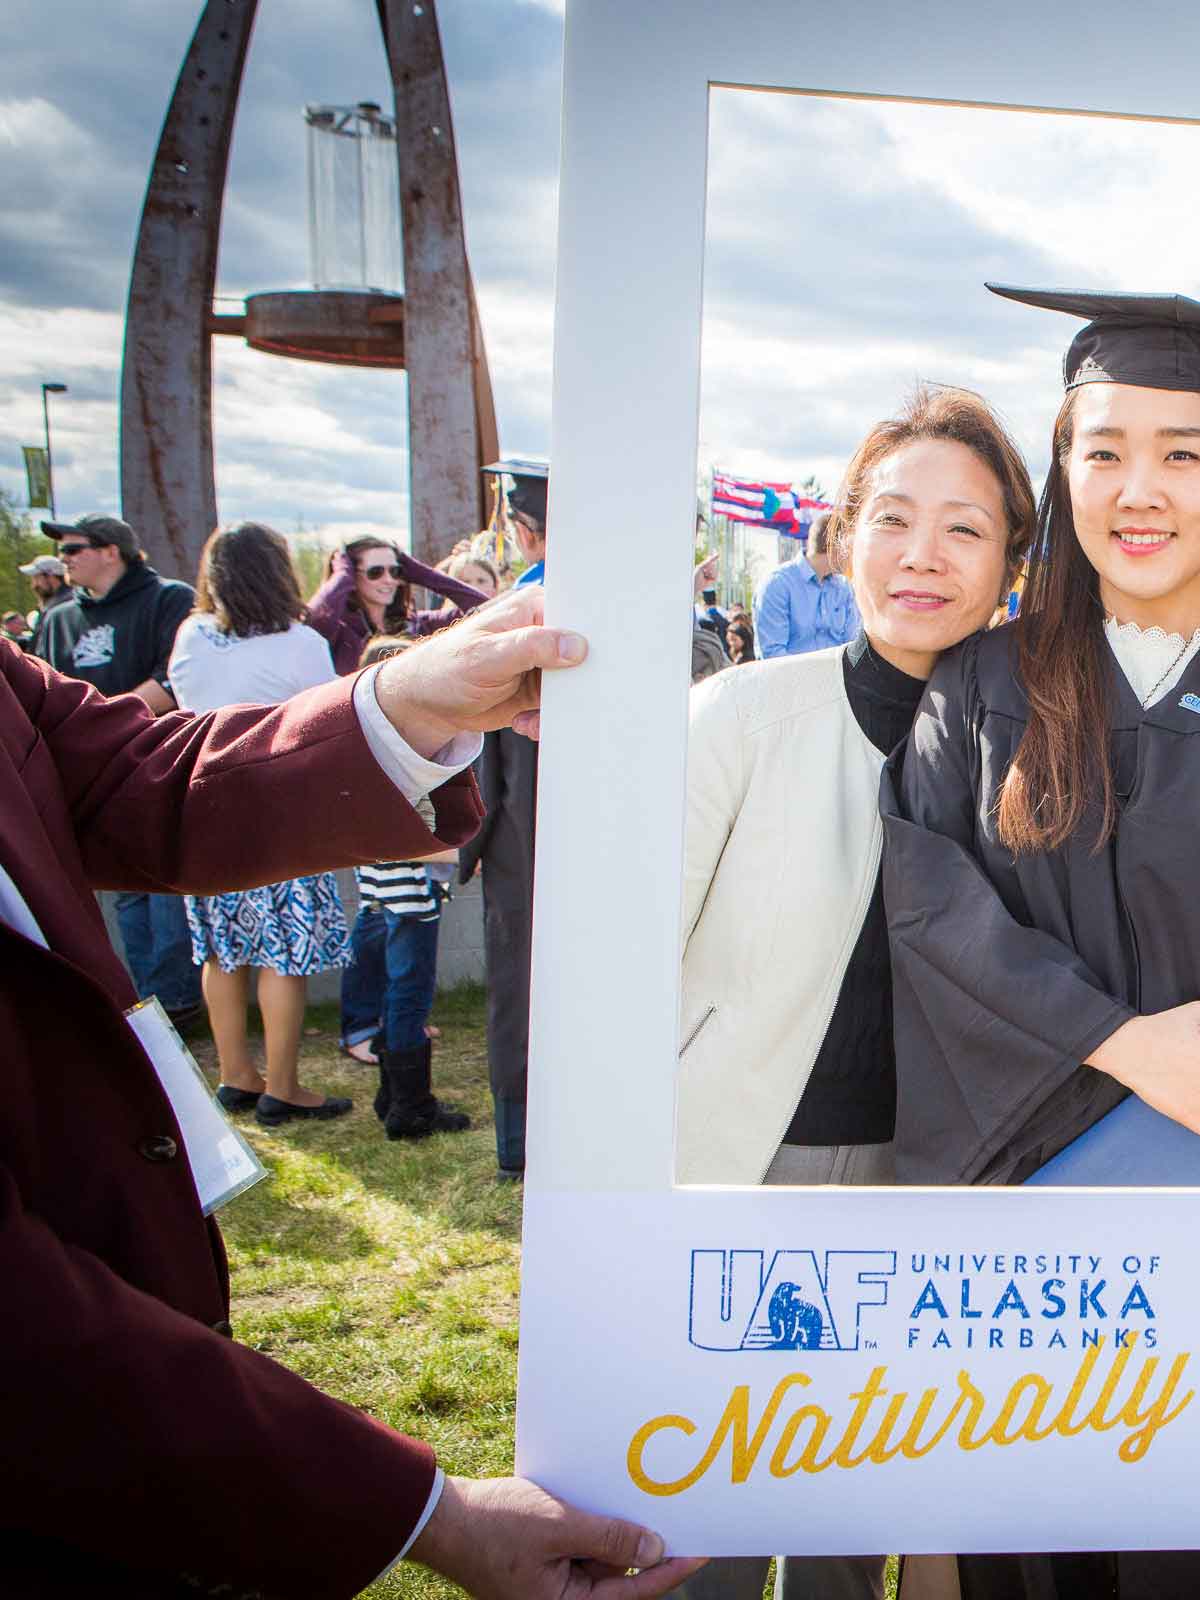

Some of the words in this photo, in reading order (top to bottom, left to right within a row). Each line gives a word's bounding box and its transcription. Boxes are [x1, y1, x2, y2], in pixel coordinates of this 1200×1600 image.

[911, 1254, 1100, 1274] UNIVERSITY
[1121, 1255, 1160, 1274] OF
[688, 1248, 897, 1352] UAF
[910, 1278, 1157, 1320] ALASKA
[908, 1328, 1157, 1350] FAIRBANKS
[626, 1331, 1195, 1497] Naturally
